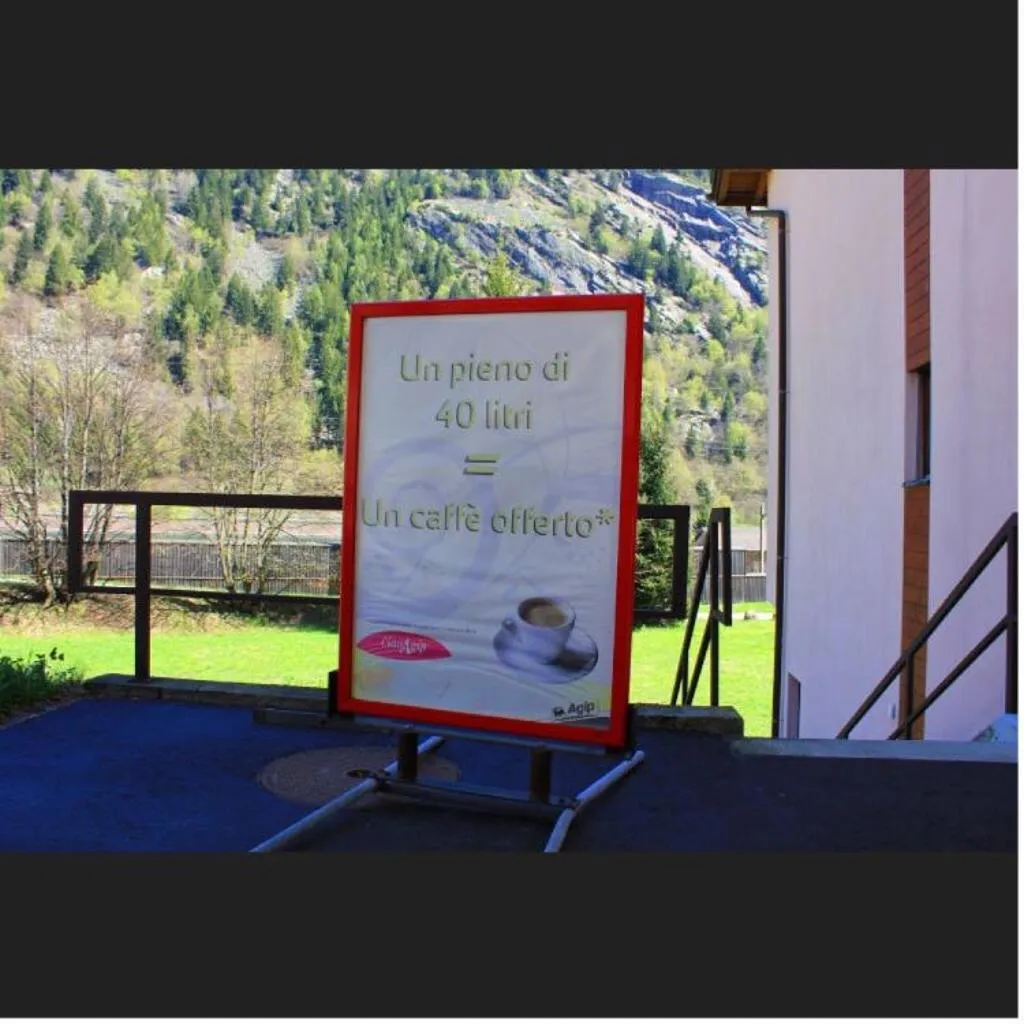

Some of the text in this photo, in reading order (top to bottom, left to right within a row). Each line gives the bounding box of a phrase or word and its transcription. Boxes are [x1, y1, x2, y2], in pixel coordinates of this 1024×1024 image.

[400, 351, 570, 389] Un pieno di
[435, 399, 532, 430] 40 litri
[362, 500, 399, 527] Un
[409, 502, 481, 533] caffè
[567, 700, 596, 716] Agip
